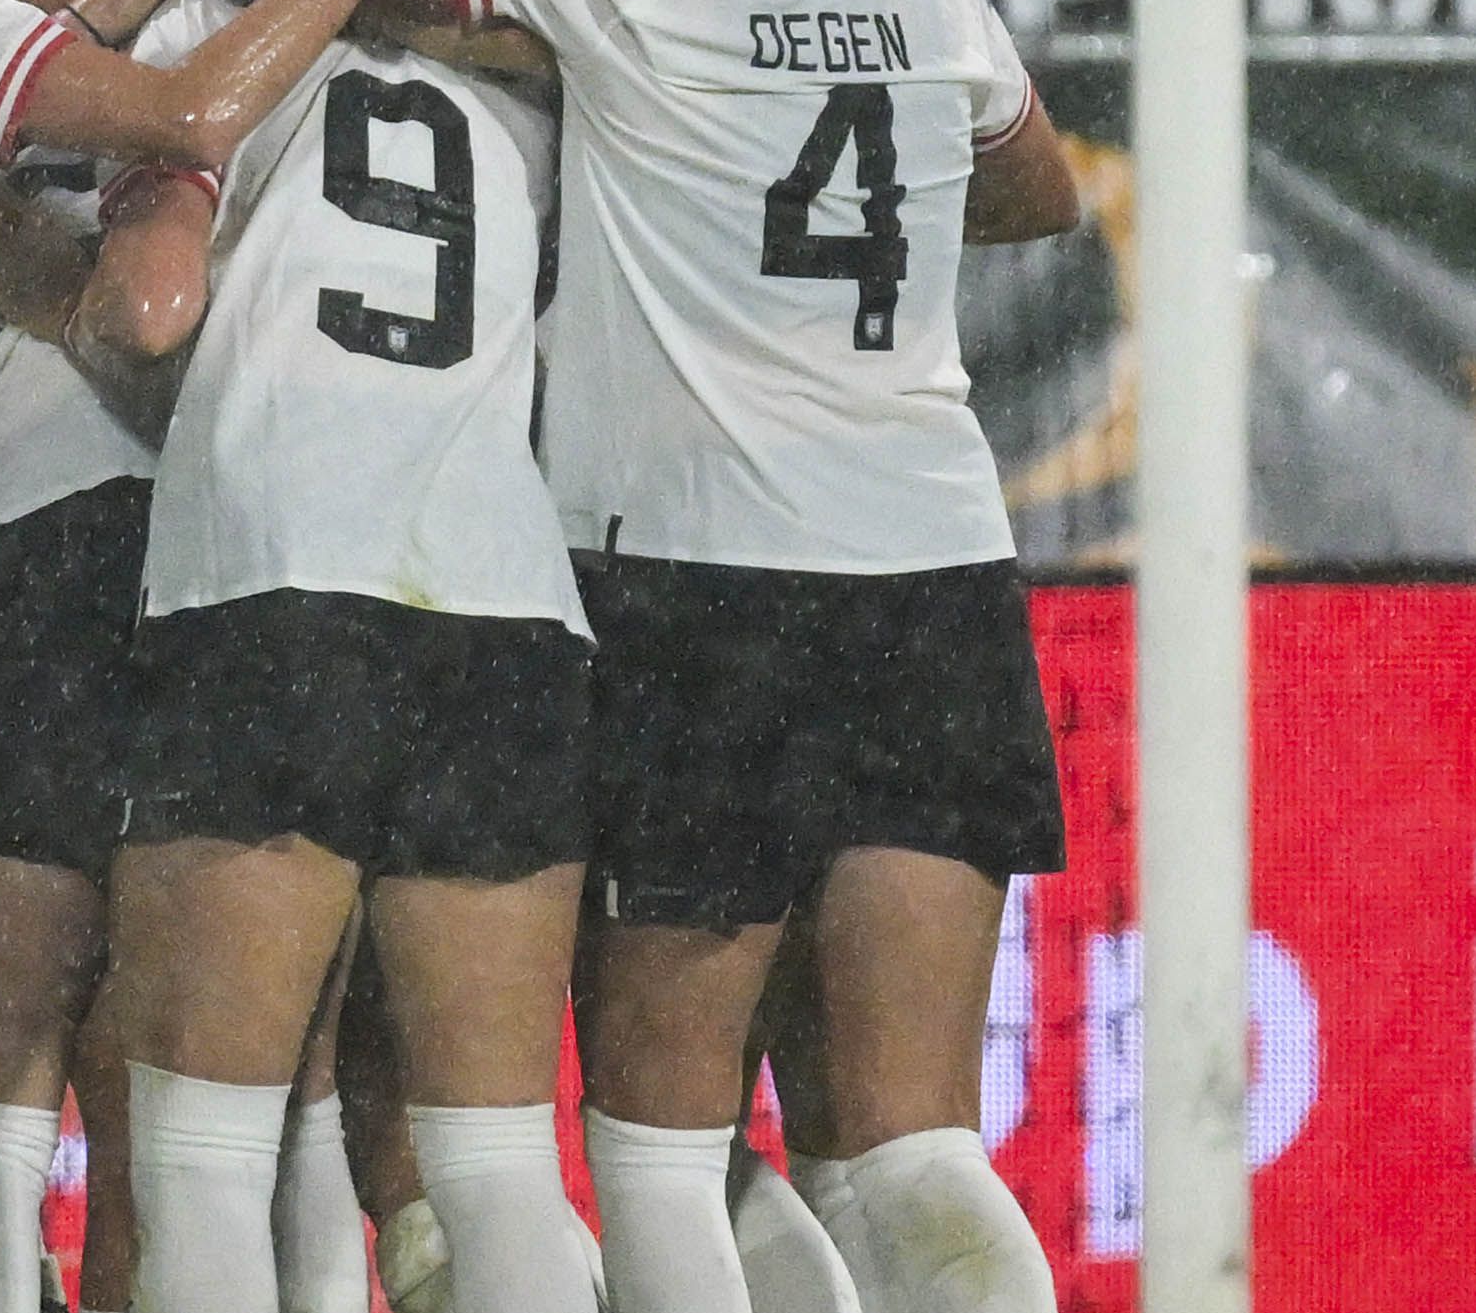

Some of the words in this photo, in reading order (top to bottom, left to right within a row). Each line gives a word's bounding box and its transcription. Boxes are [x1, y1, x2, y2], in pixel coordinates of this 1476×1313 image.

[750, 13, 912, 72] DEGEN
[317, 69, 475, 369] 9
[760, 83, 909, 351] 4
